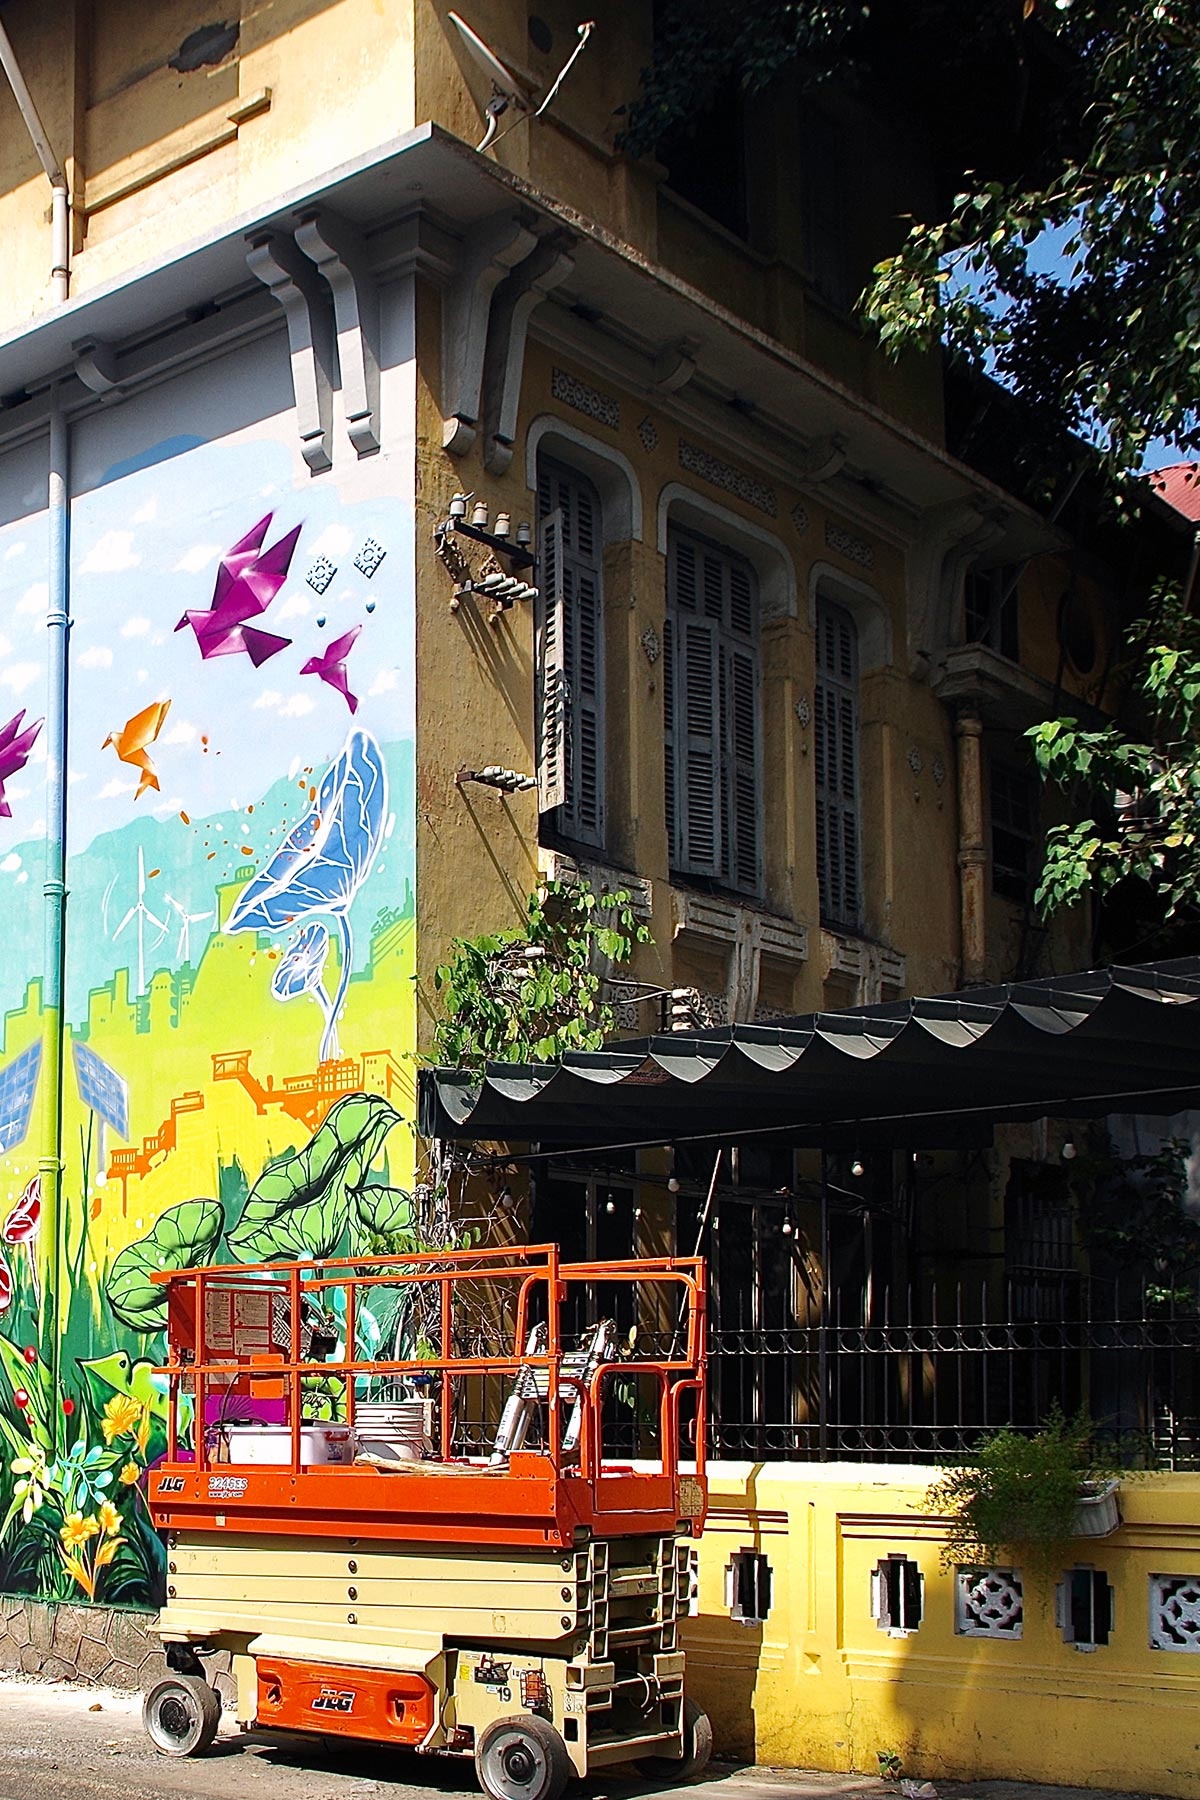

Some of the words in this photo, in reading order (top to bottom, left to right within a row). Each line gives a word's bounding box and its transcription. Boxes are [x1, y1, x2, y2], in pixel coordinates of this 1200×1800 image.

[158, 1476, 185, 1492] JLG
[208, 1476, 248, 1490] 3246ES
[312, 1689, 355, 1713] JLG
[497, 1686, 512, 1702] 19
